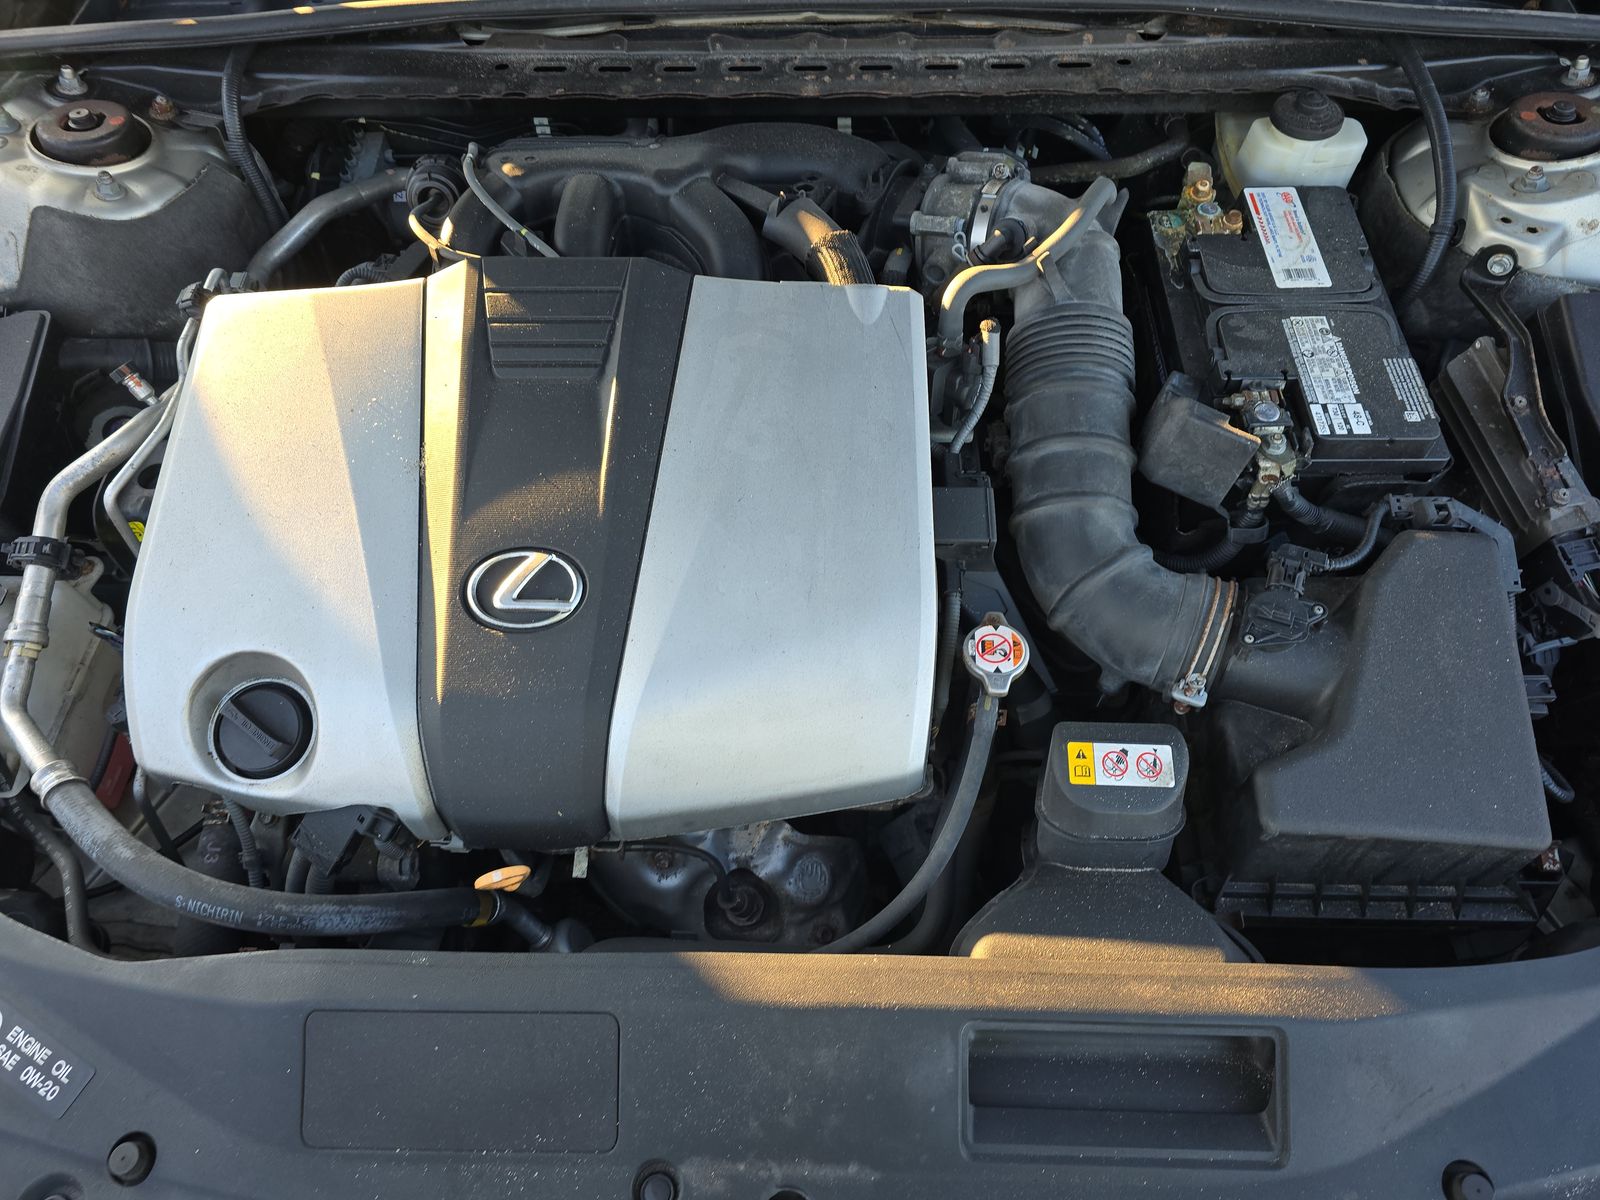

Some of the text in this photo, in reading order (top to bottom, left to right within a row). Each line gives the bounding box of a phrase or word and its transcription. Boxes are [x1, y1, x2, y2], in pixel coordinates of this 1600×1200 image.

[5, 1025, 73, 1084] ENGINE OIL
[19, 1065, 60, 1101] 0W-20
